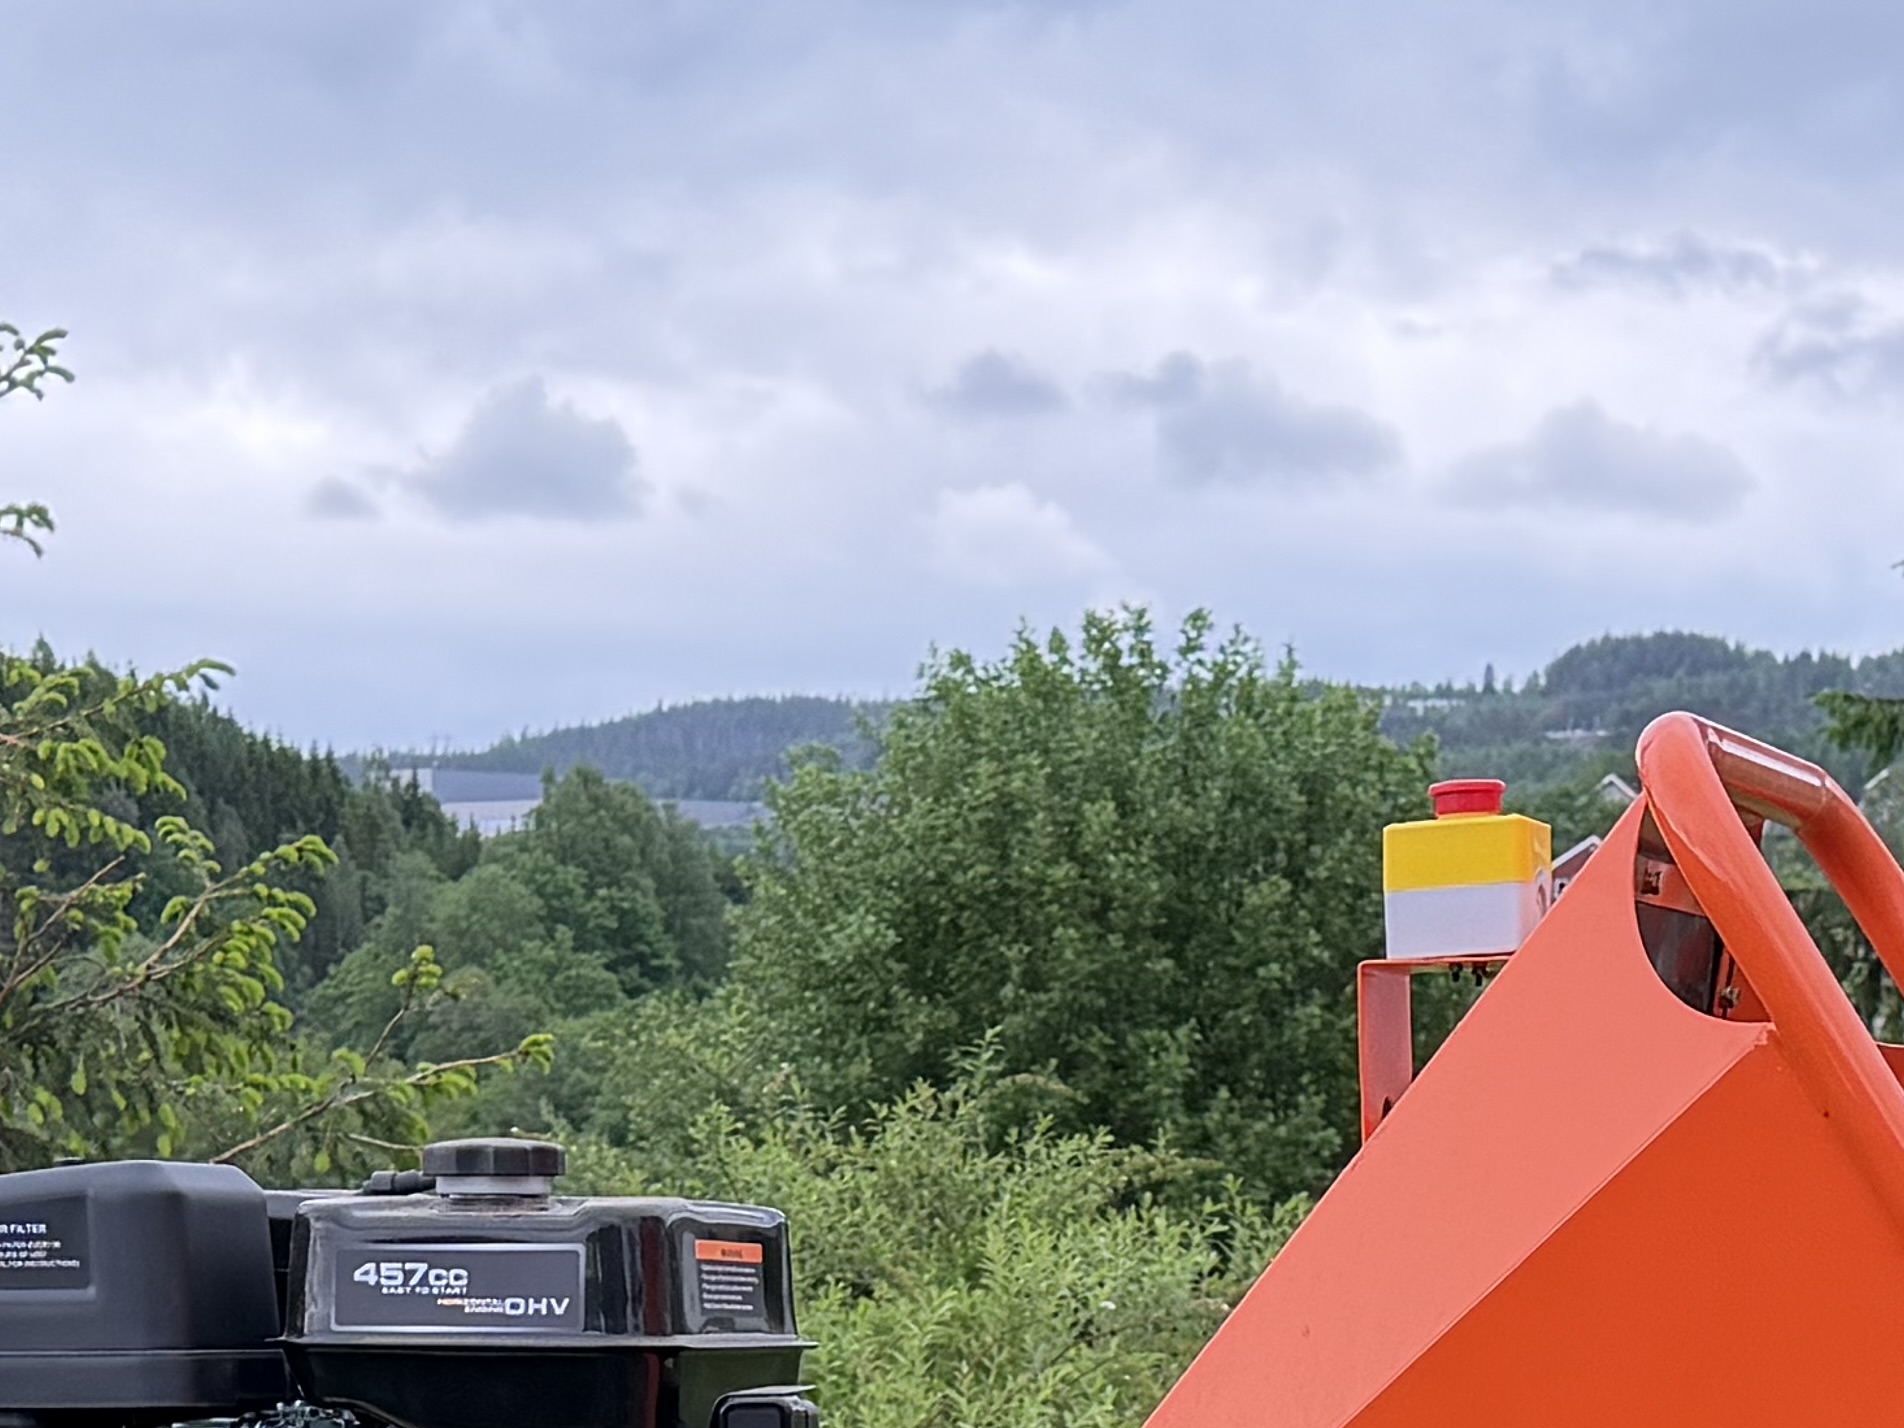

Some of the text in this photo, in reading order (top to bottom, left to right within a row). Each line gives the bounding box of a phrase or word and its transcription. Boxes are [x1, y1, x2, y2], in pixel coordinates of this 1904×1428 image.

[10, 1223, 47, 1234] FILTER
[353, 1262, 468, 1286] 457cc
[504, 1297, 570, 1315] OHV
